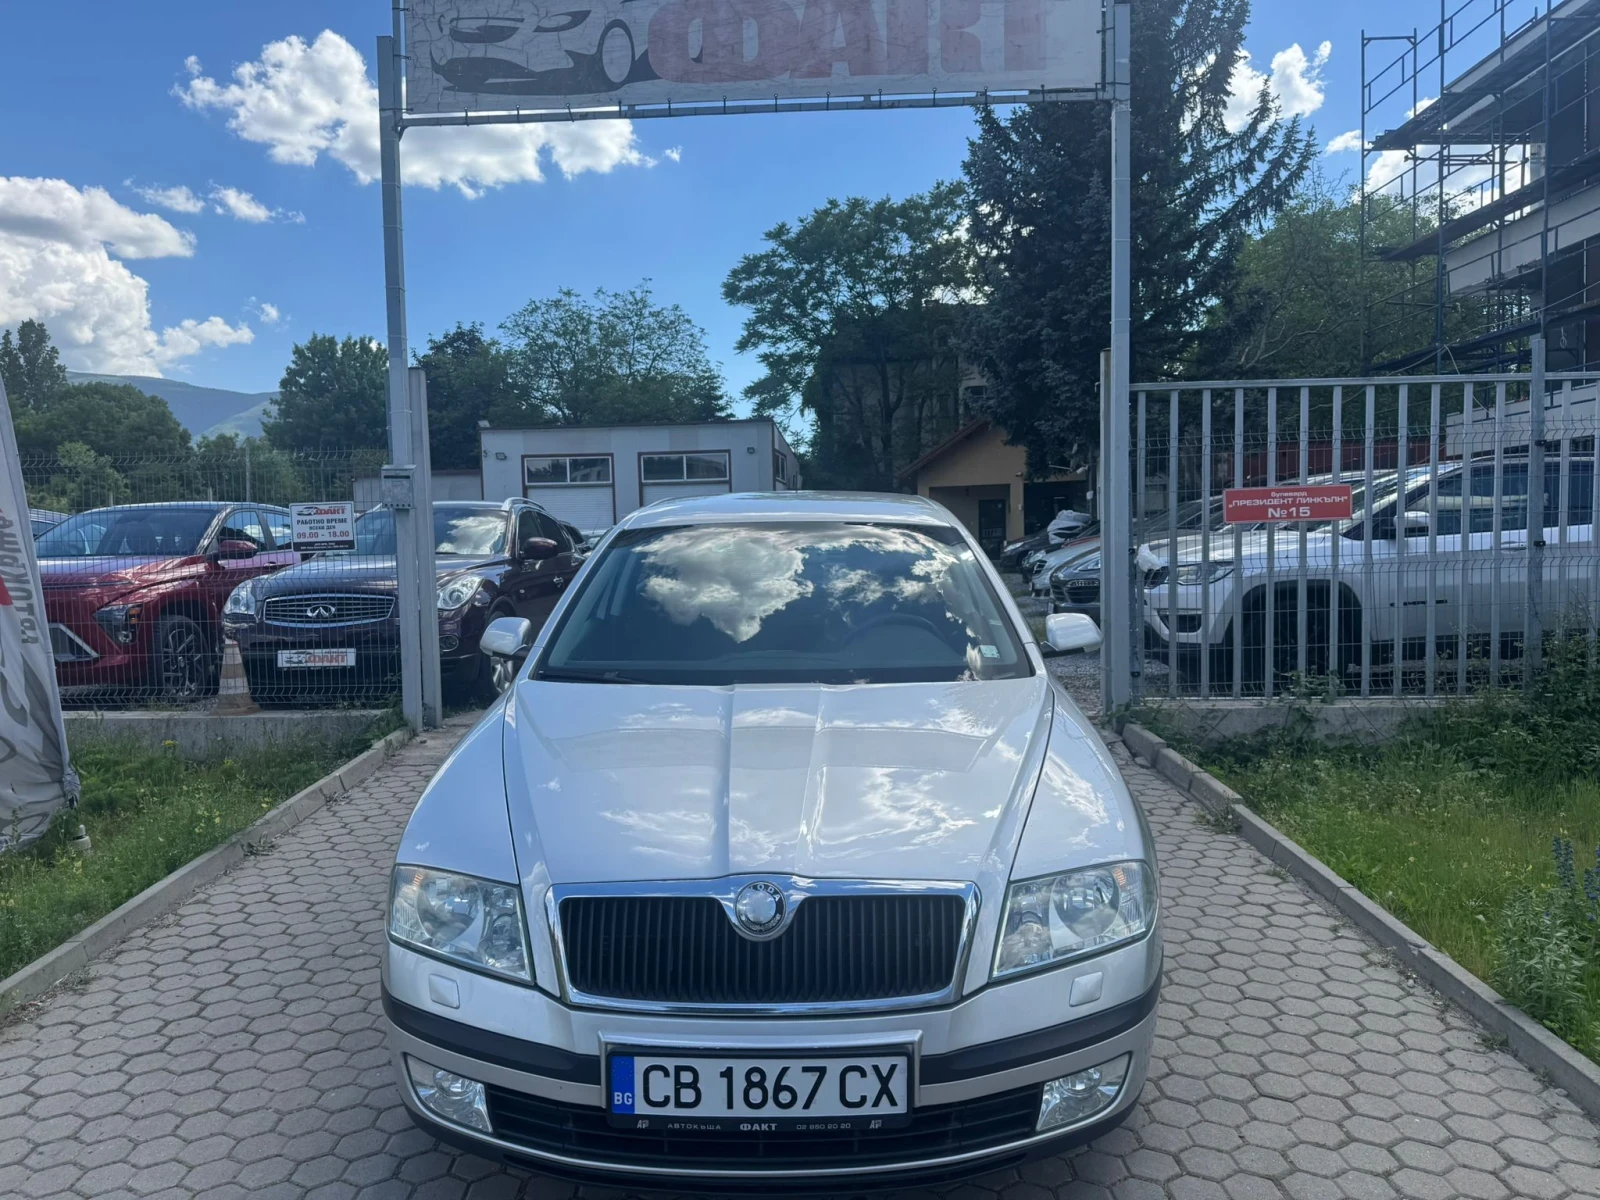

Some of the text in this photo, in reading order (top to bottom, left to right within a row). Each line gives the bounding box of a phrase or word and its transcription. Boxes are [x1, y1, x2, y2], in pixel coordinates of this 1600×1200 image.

[1270, 491, 1308, 499] булевард
[296, 531, 319, 539] 09.00
[328, 530, 350, 538] 18.00
[642, 1063, 899, 1111] CB 1867 CX
[613, 1091, 633, 1105] BG
[739, 1122, 778, 1131] ФАКТ
